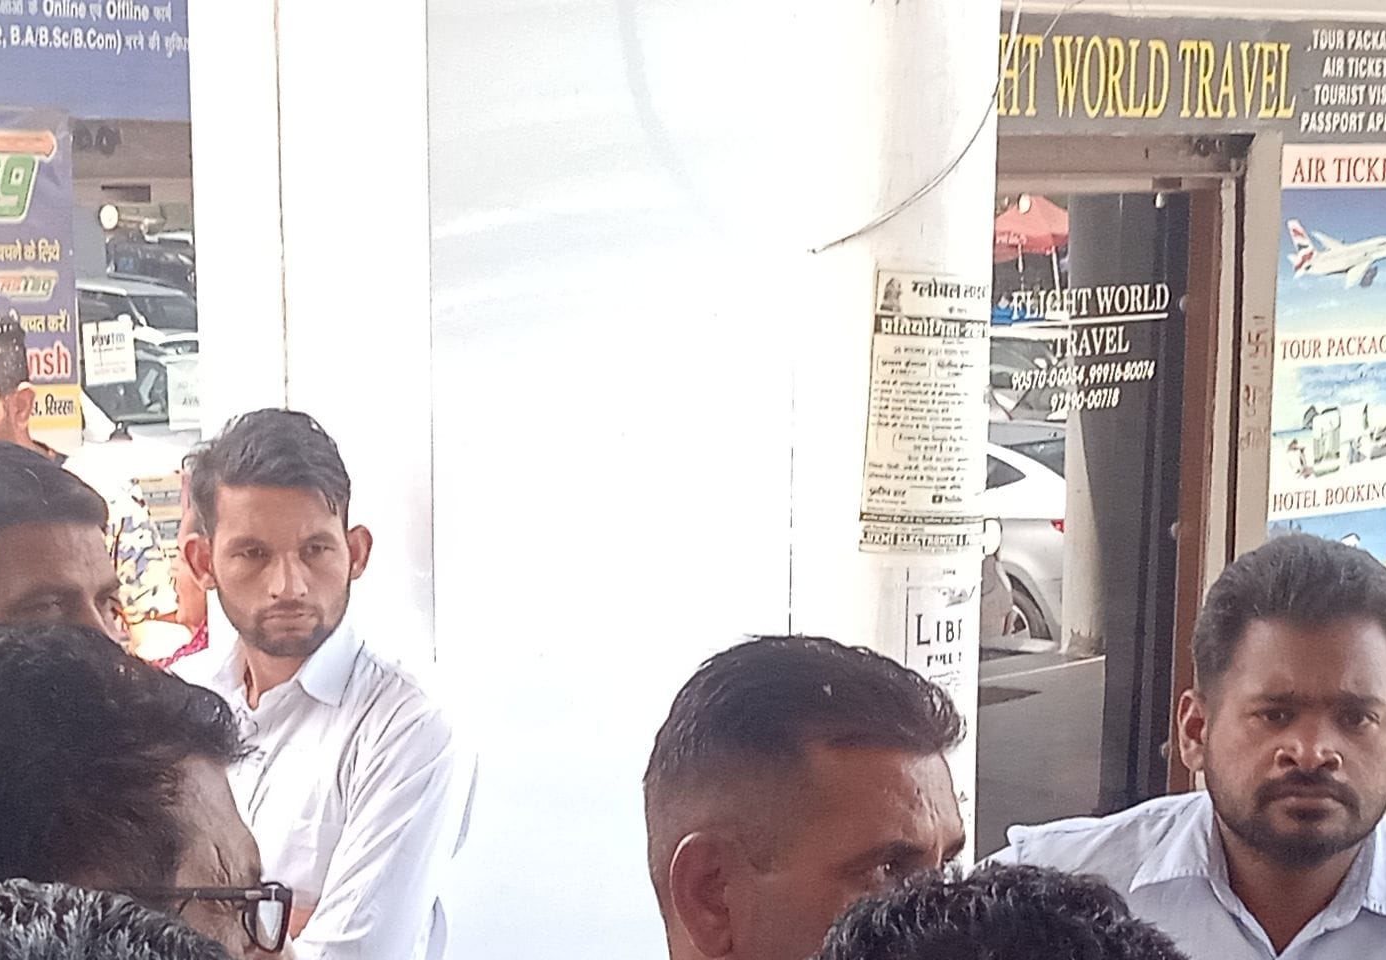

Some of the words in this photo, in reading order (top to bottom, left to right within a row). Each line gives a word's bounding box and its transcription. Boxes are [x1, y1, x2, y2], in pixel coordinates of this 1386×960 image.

[42, 0, 86, 18] Online
[106, 0, 149, 21] Offline
[1312, 28, 1345, 50] TOUR
[997, 32, 1044, 117] HT
[1051, 34, 1170, 118] WORLD
[1177, 38, 1296, 119] TRAVEL
[1322, 56, 1345, 78] AIR
[1313, 84, 1366, 106] TOURIST
[1300, 111, 1365, 133] PASSPORT
[1291, 157, 1327, 184] AIR
[1011, 287, 1092, 321] FLIGHT
[1096, 283, 1171, 315] WORLD
[1052, 325, 1131, 359] TRAVEL
[1280, 339, 1322, 361] TOUR
[28, 344, 71, 377] nsh
[1272, 490, 1321, 512] HOTEL
